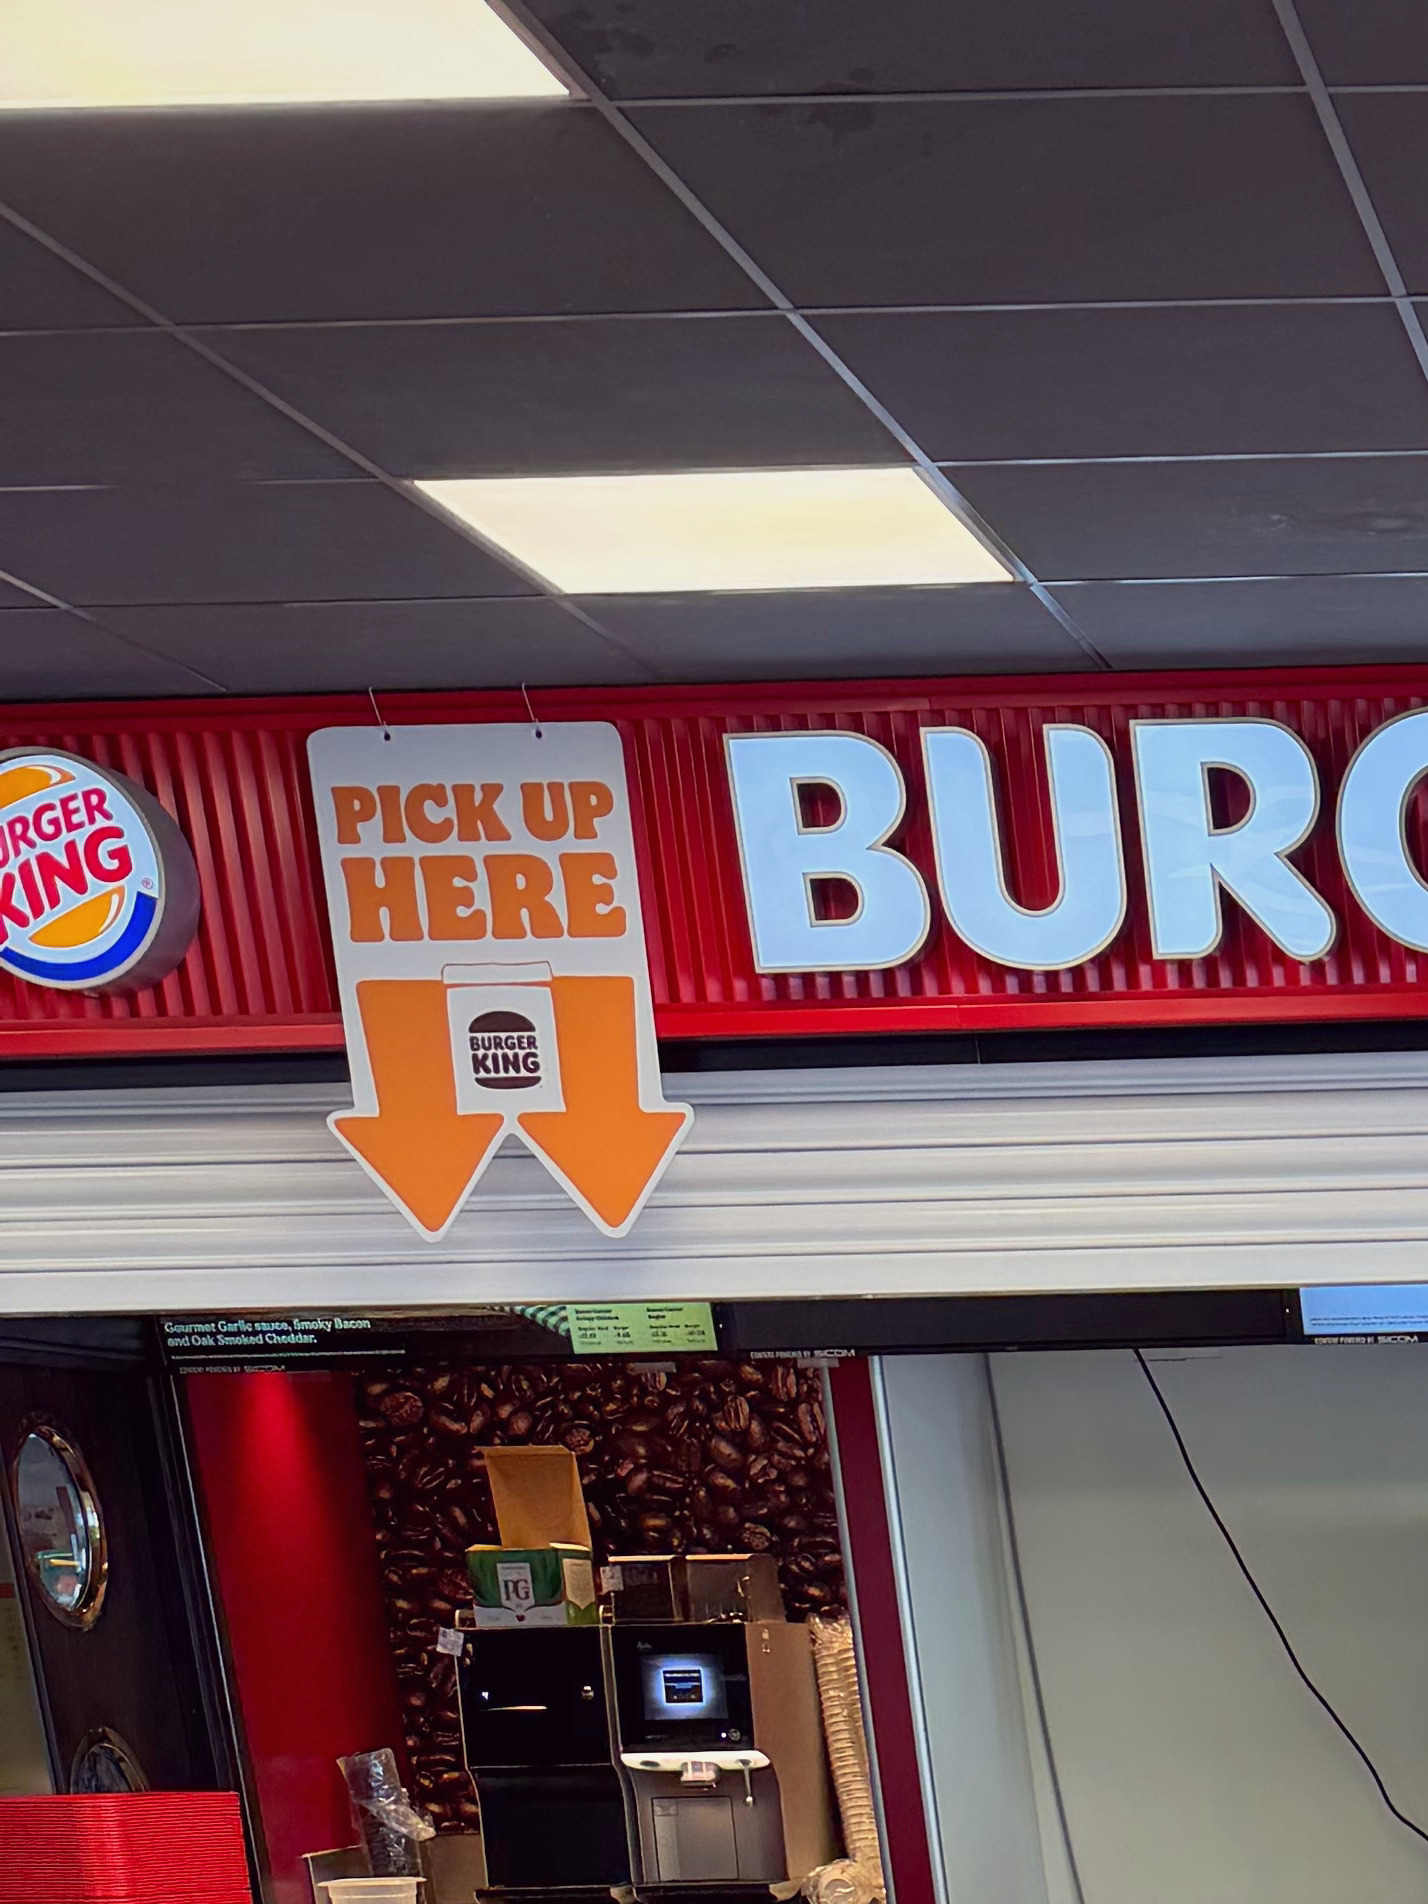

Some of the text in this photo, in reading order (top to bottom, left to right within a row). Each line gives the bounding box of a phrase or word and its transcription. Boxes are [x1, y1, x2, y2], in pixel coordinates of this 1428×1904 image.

[331, 781, 614, 844] PICK UP
[0, 787, 113, 868] RGER
[340, 852, 627, 942] HERE
[469, 1035, 538, 1051] BURGER
[471, 1052, 541, 1075] KING
[164, 1321, 216, 1334] Gourmet
[218, 1320, 252, 1332] Garlic
[335, 1318, 371, 1329] Bacon
[167, 1335, 190, 1347] and
[191, 1334, 216, 1346] Oak
[217, 1333, 263, 1346] Smoked
[503, 1578, 530, 1601] PG
